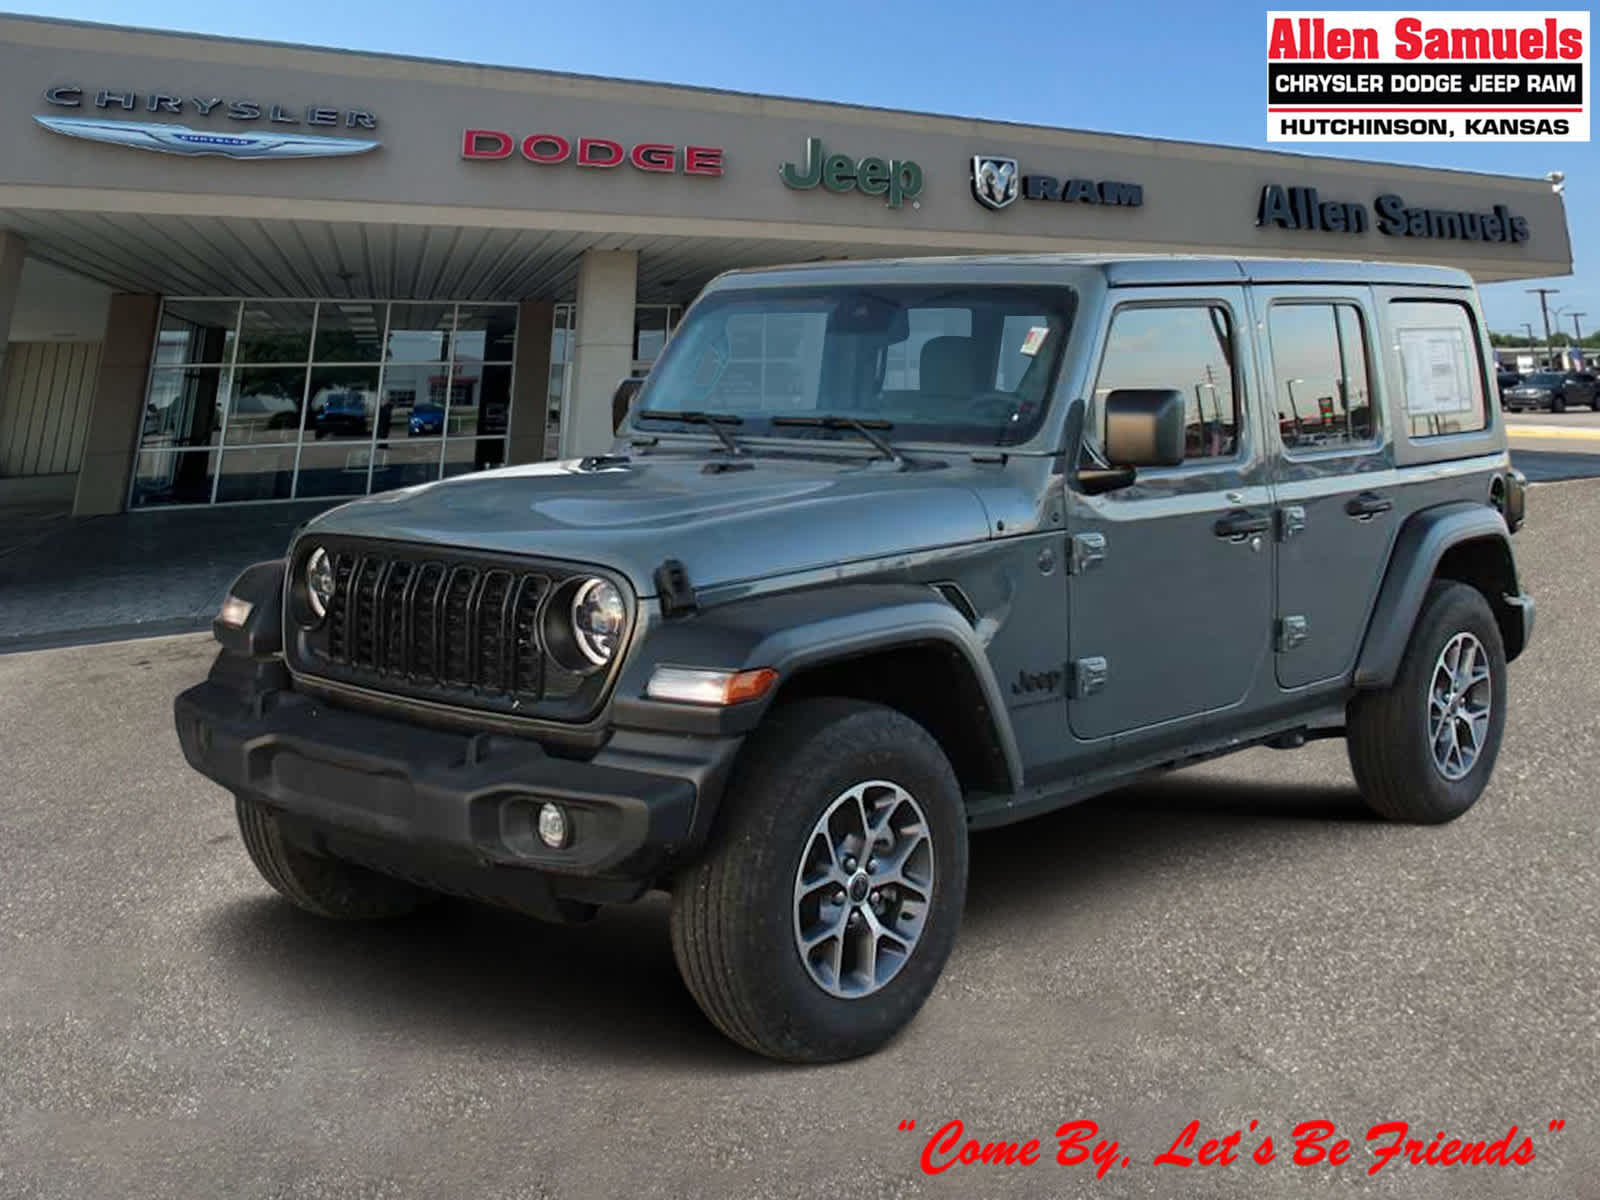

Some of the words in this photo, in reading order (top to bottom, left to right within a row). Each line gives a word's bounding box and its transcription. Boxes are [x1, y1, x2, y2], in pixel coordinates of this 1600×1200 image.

[45, 86, 377, 129] CHRYSLER
[461, 128, 724, 176] DODGE
[779, 137, 923, 209] Jeep
[1022, 175, 1143, 207] RAM
[1256, 184, 1369, 233] Allen
[1374, 194, 1530, 243] Samuels
[1011, 668, 1061, 695] Jeep
